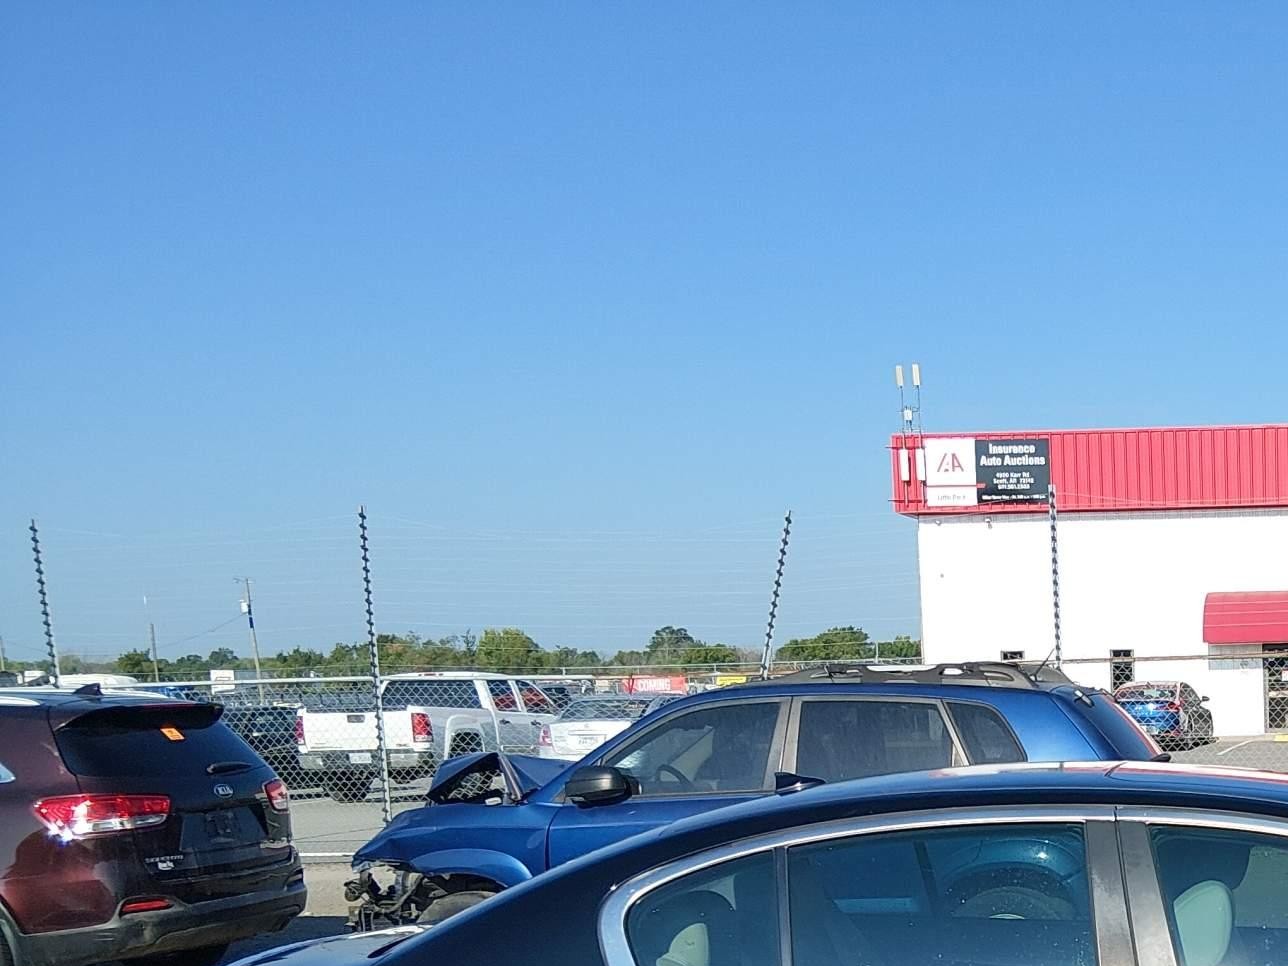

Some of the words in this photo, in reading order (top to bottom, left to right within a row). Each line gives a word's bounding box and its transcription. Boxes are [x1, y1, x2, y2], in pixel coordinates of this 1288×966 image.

[989, 443, 1035, 454] Insurance
[980, 455, 1002, 466] Auto
[1003, 454, 1046, 466] Auctions
[638, 678, 671, 692] COMING
[216, 786, 233, 796] KIA
